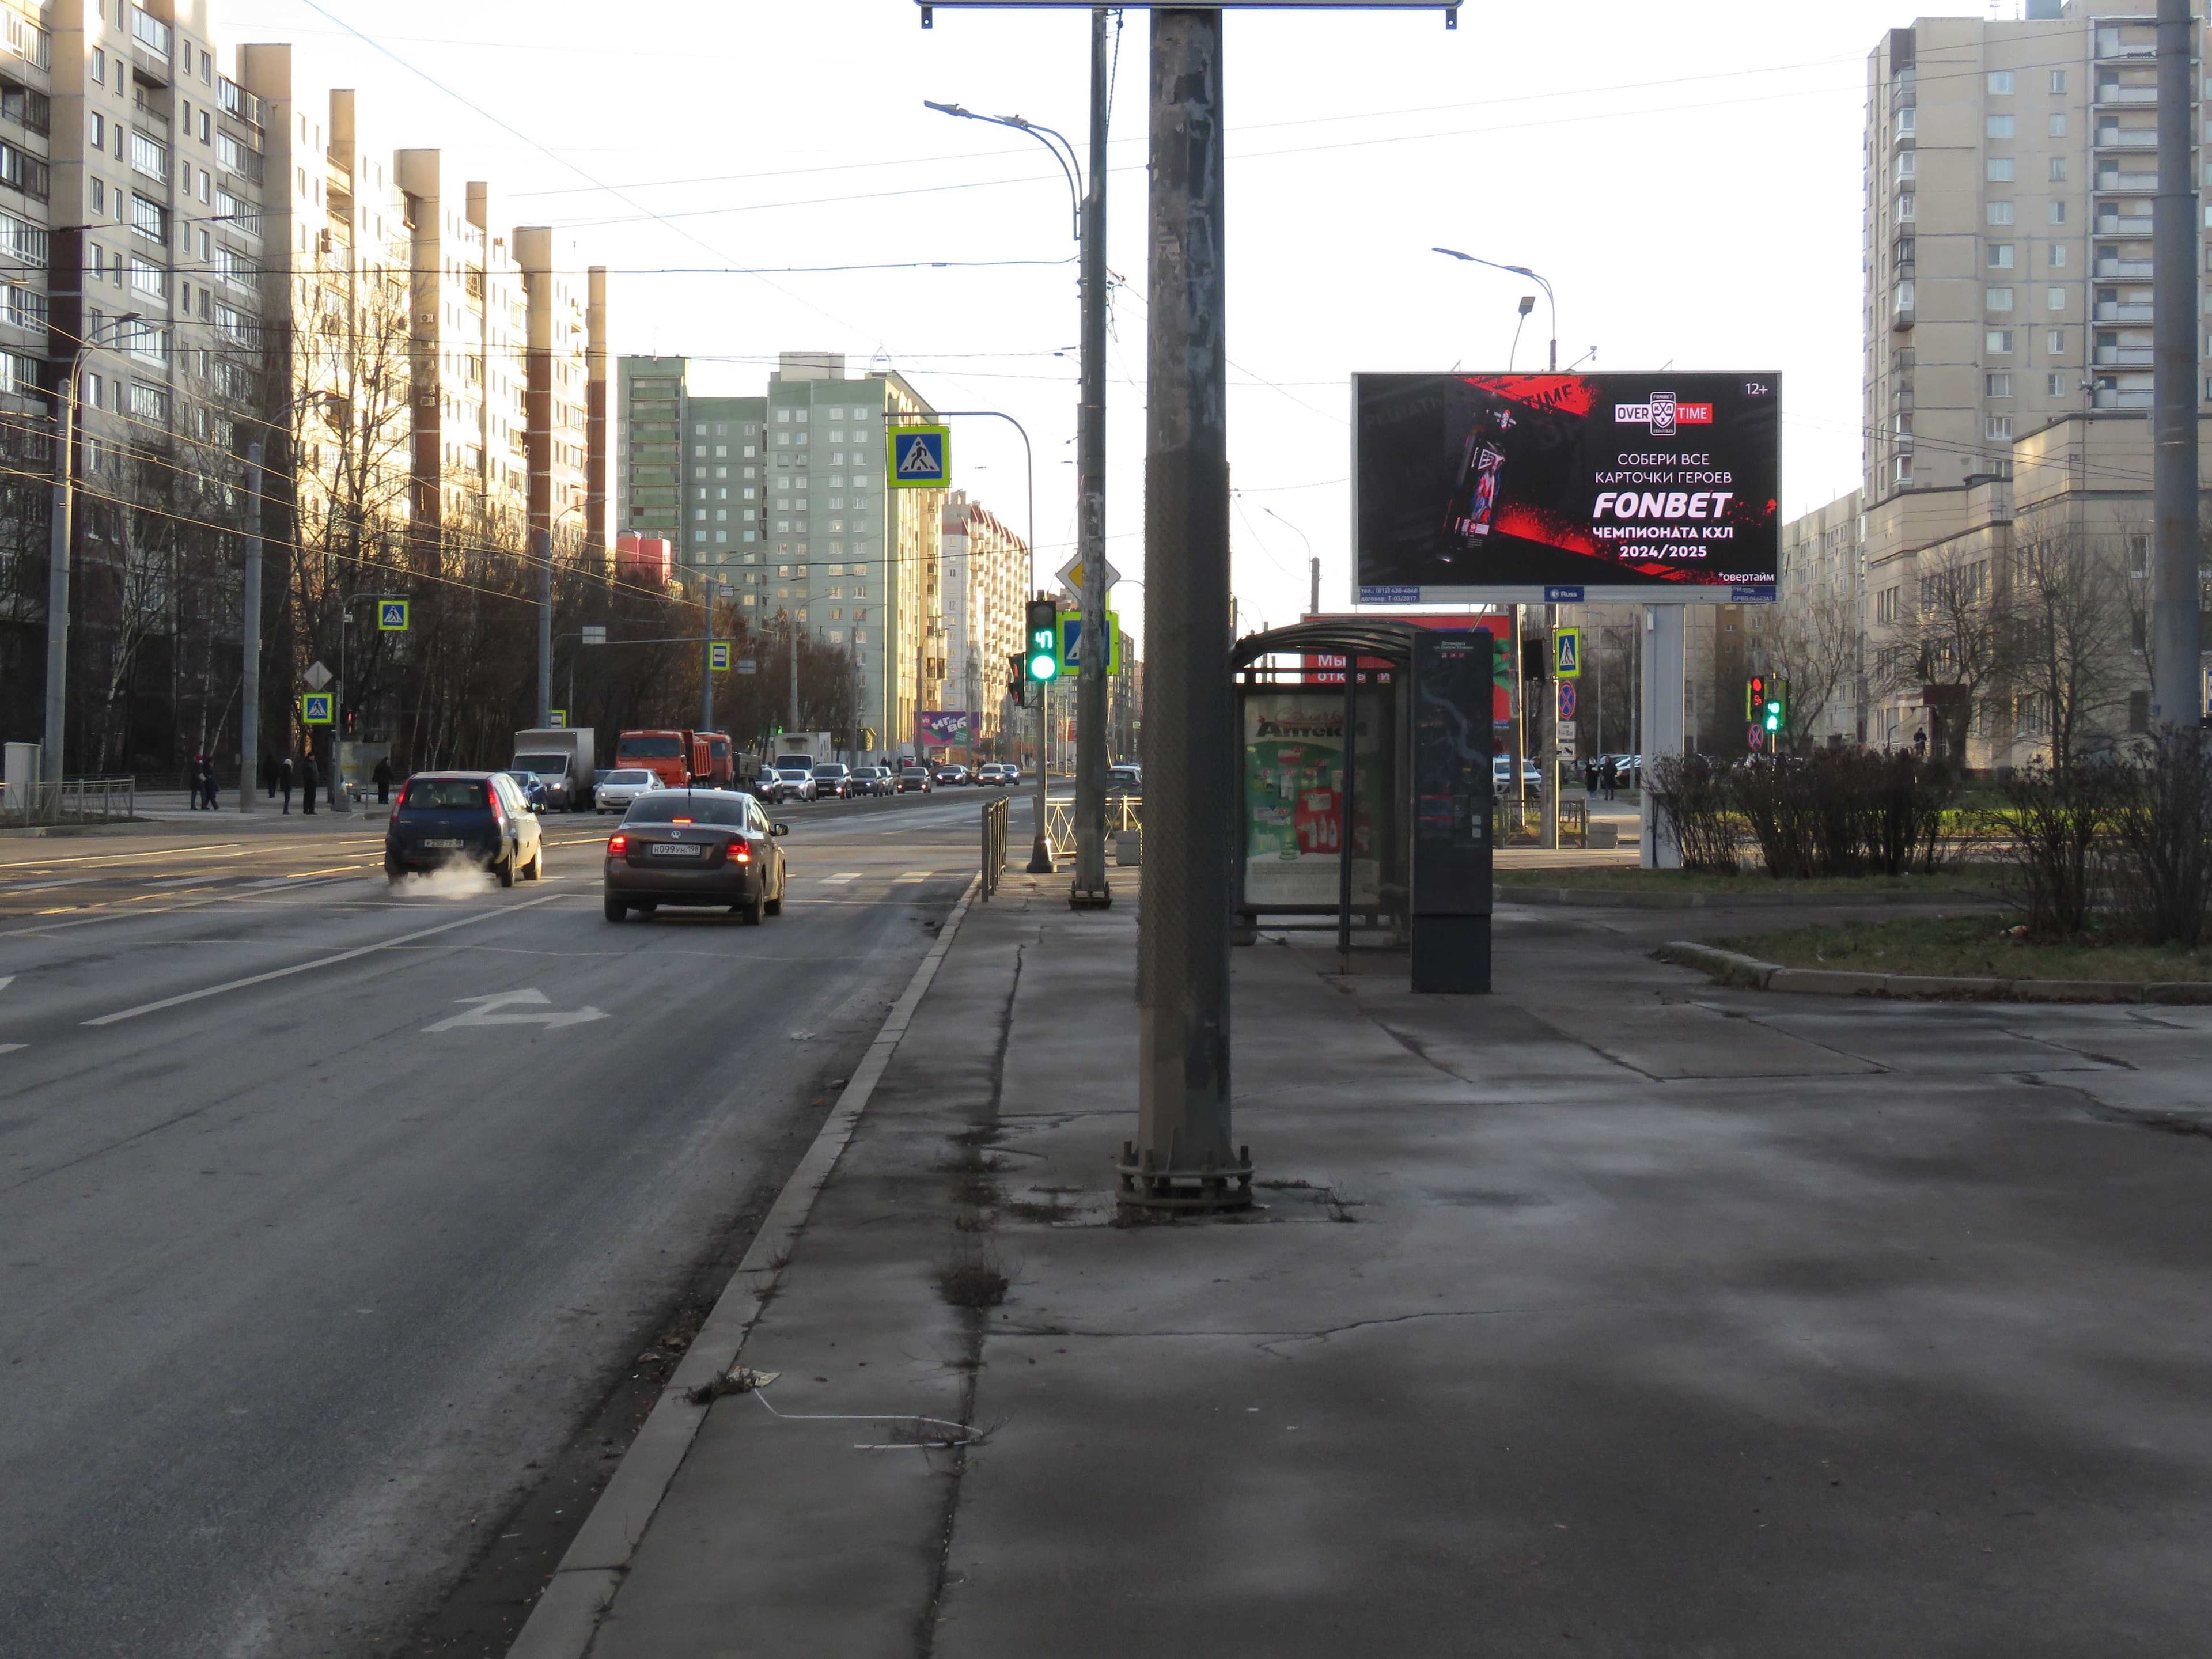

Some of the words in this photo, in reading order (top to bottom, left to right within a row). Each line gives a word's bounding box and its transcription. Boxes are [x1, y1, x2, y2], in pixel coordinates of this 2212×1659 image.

[1745, 382, 1768, 395] 12+
[1617, 407, 1649, 419] OVER
[1677, 407, 1707, 419] TIME
[1618, 453, 1676, 465] СОБЕРИ
[1681, 453, 1710, 465] ВСЕ
[1595, 471, 1673, 483] КАРТОЧКИ
[1678, 471, 1732, 483] ГЕРОЕВ
[1593, 491, 1733, 518] FONBET
[1592, 527, 1699, 539] ЧЕМПИОНАТА
[1702, 527, 1733, 539] КХЛ
[1619, 544, 1707, 559] 2024/2025
[1317, 654, 1346, 666] Мы
